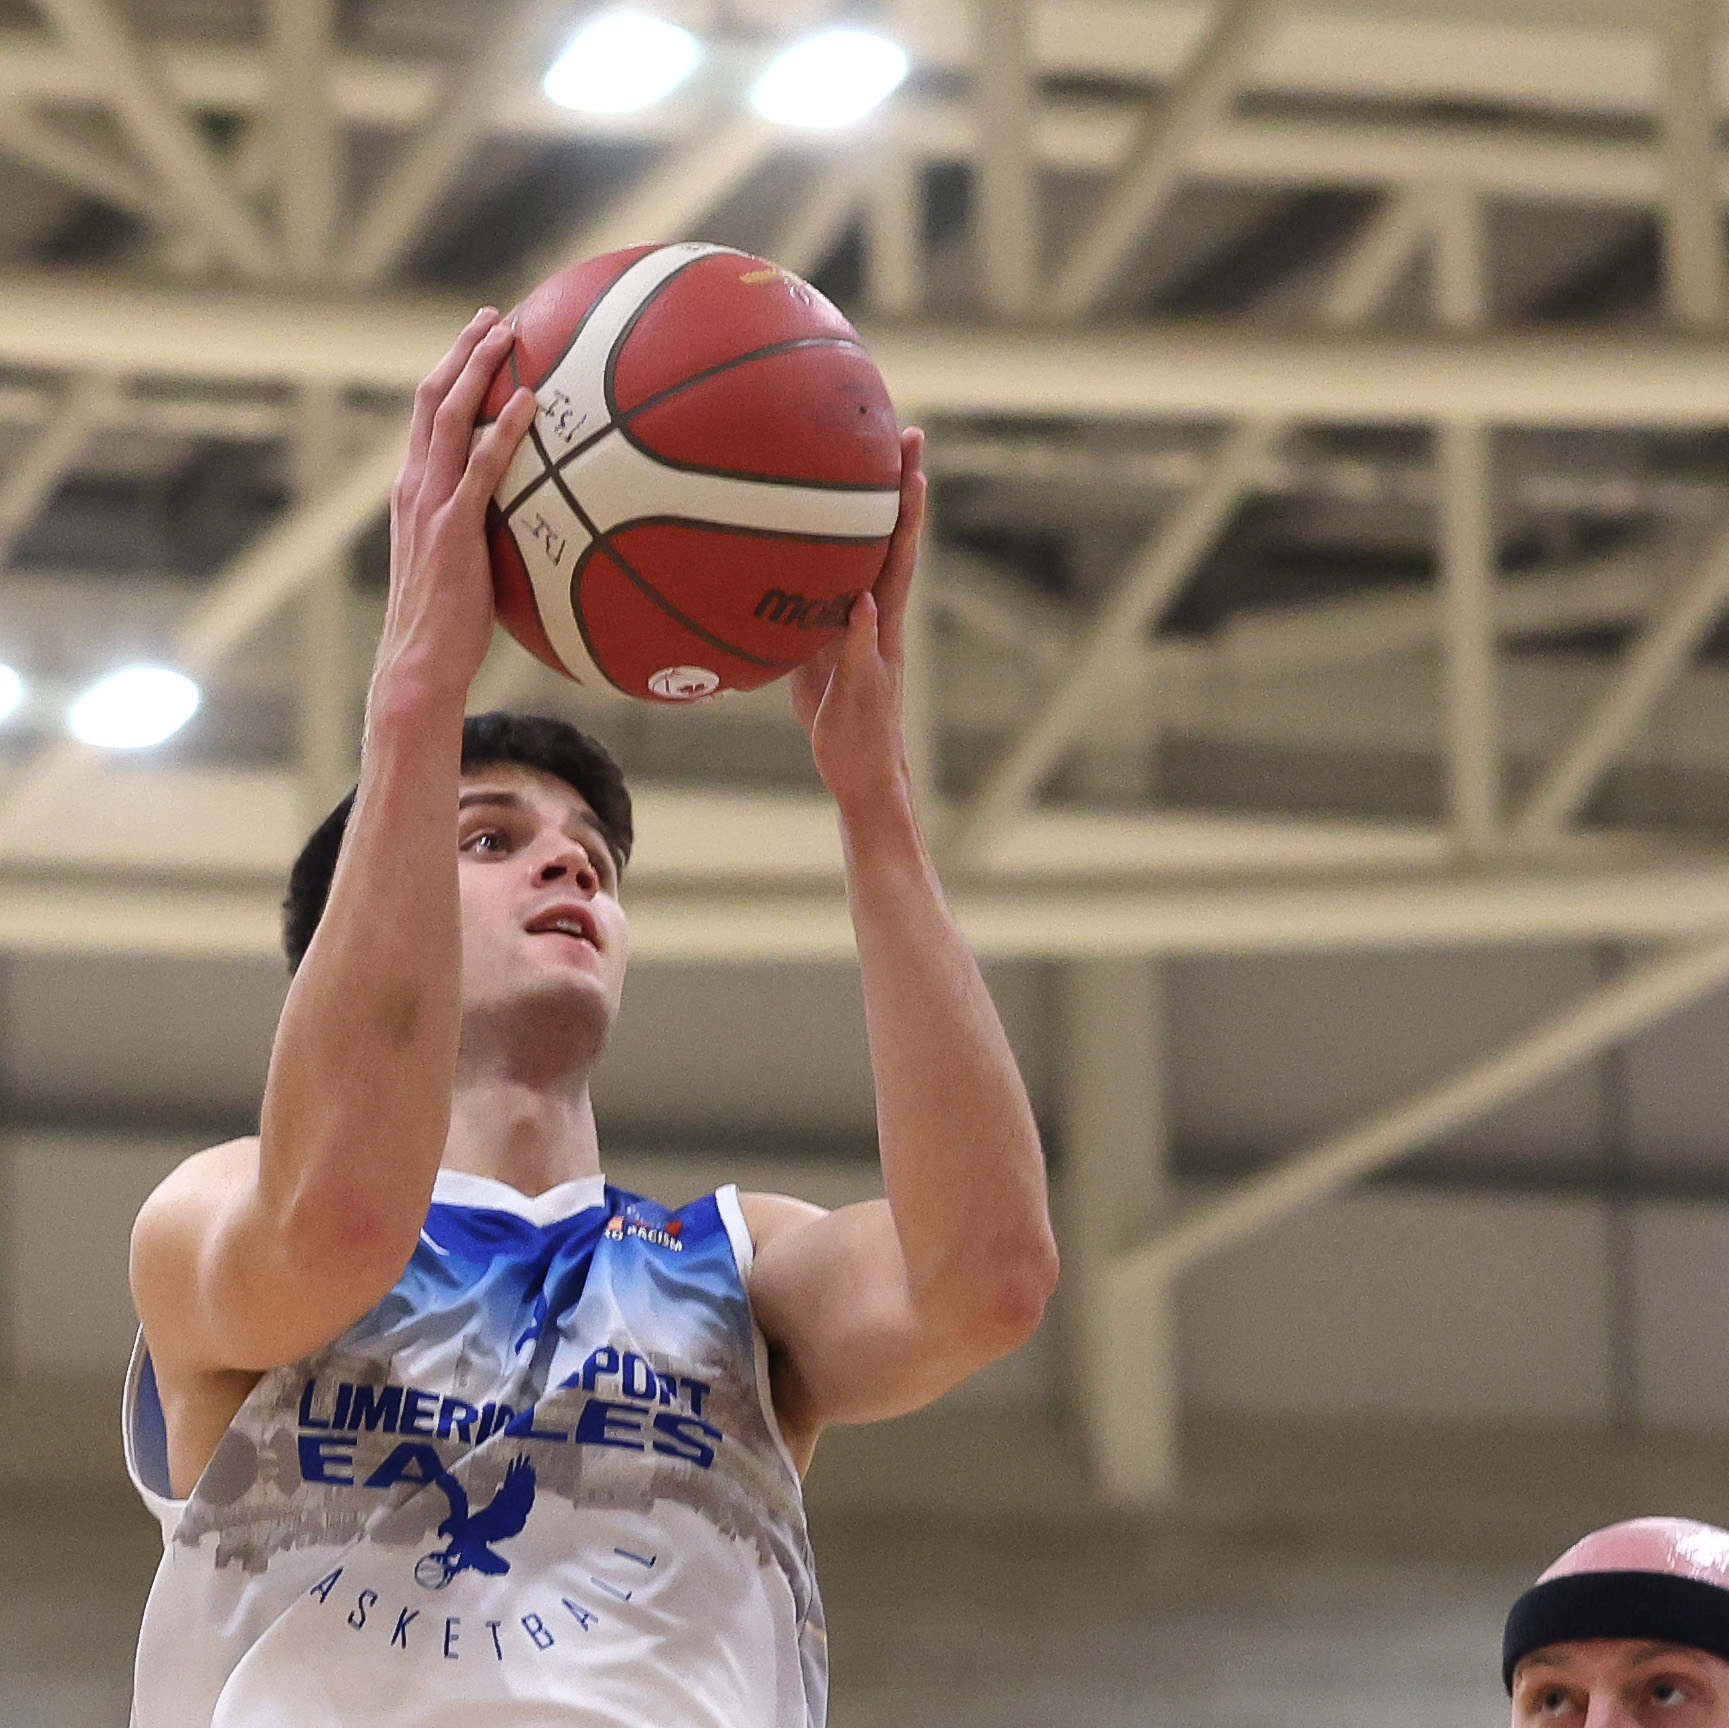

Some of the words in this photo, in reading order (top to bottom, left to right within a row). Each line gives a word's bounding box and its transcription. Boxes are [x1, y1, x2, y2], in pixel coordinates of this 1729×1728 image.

[297, 1397, 724, 1488] EALES
[298, 1378, 514, 1446] LIMERI
[558, 1345, 711, 1417] PORT
[309, 1546, 657, 1661] ASKETBALL
